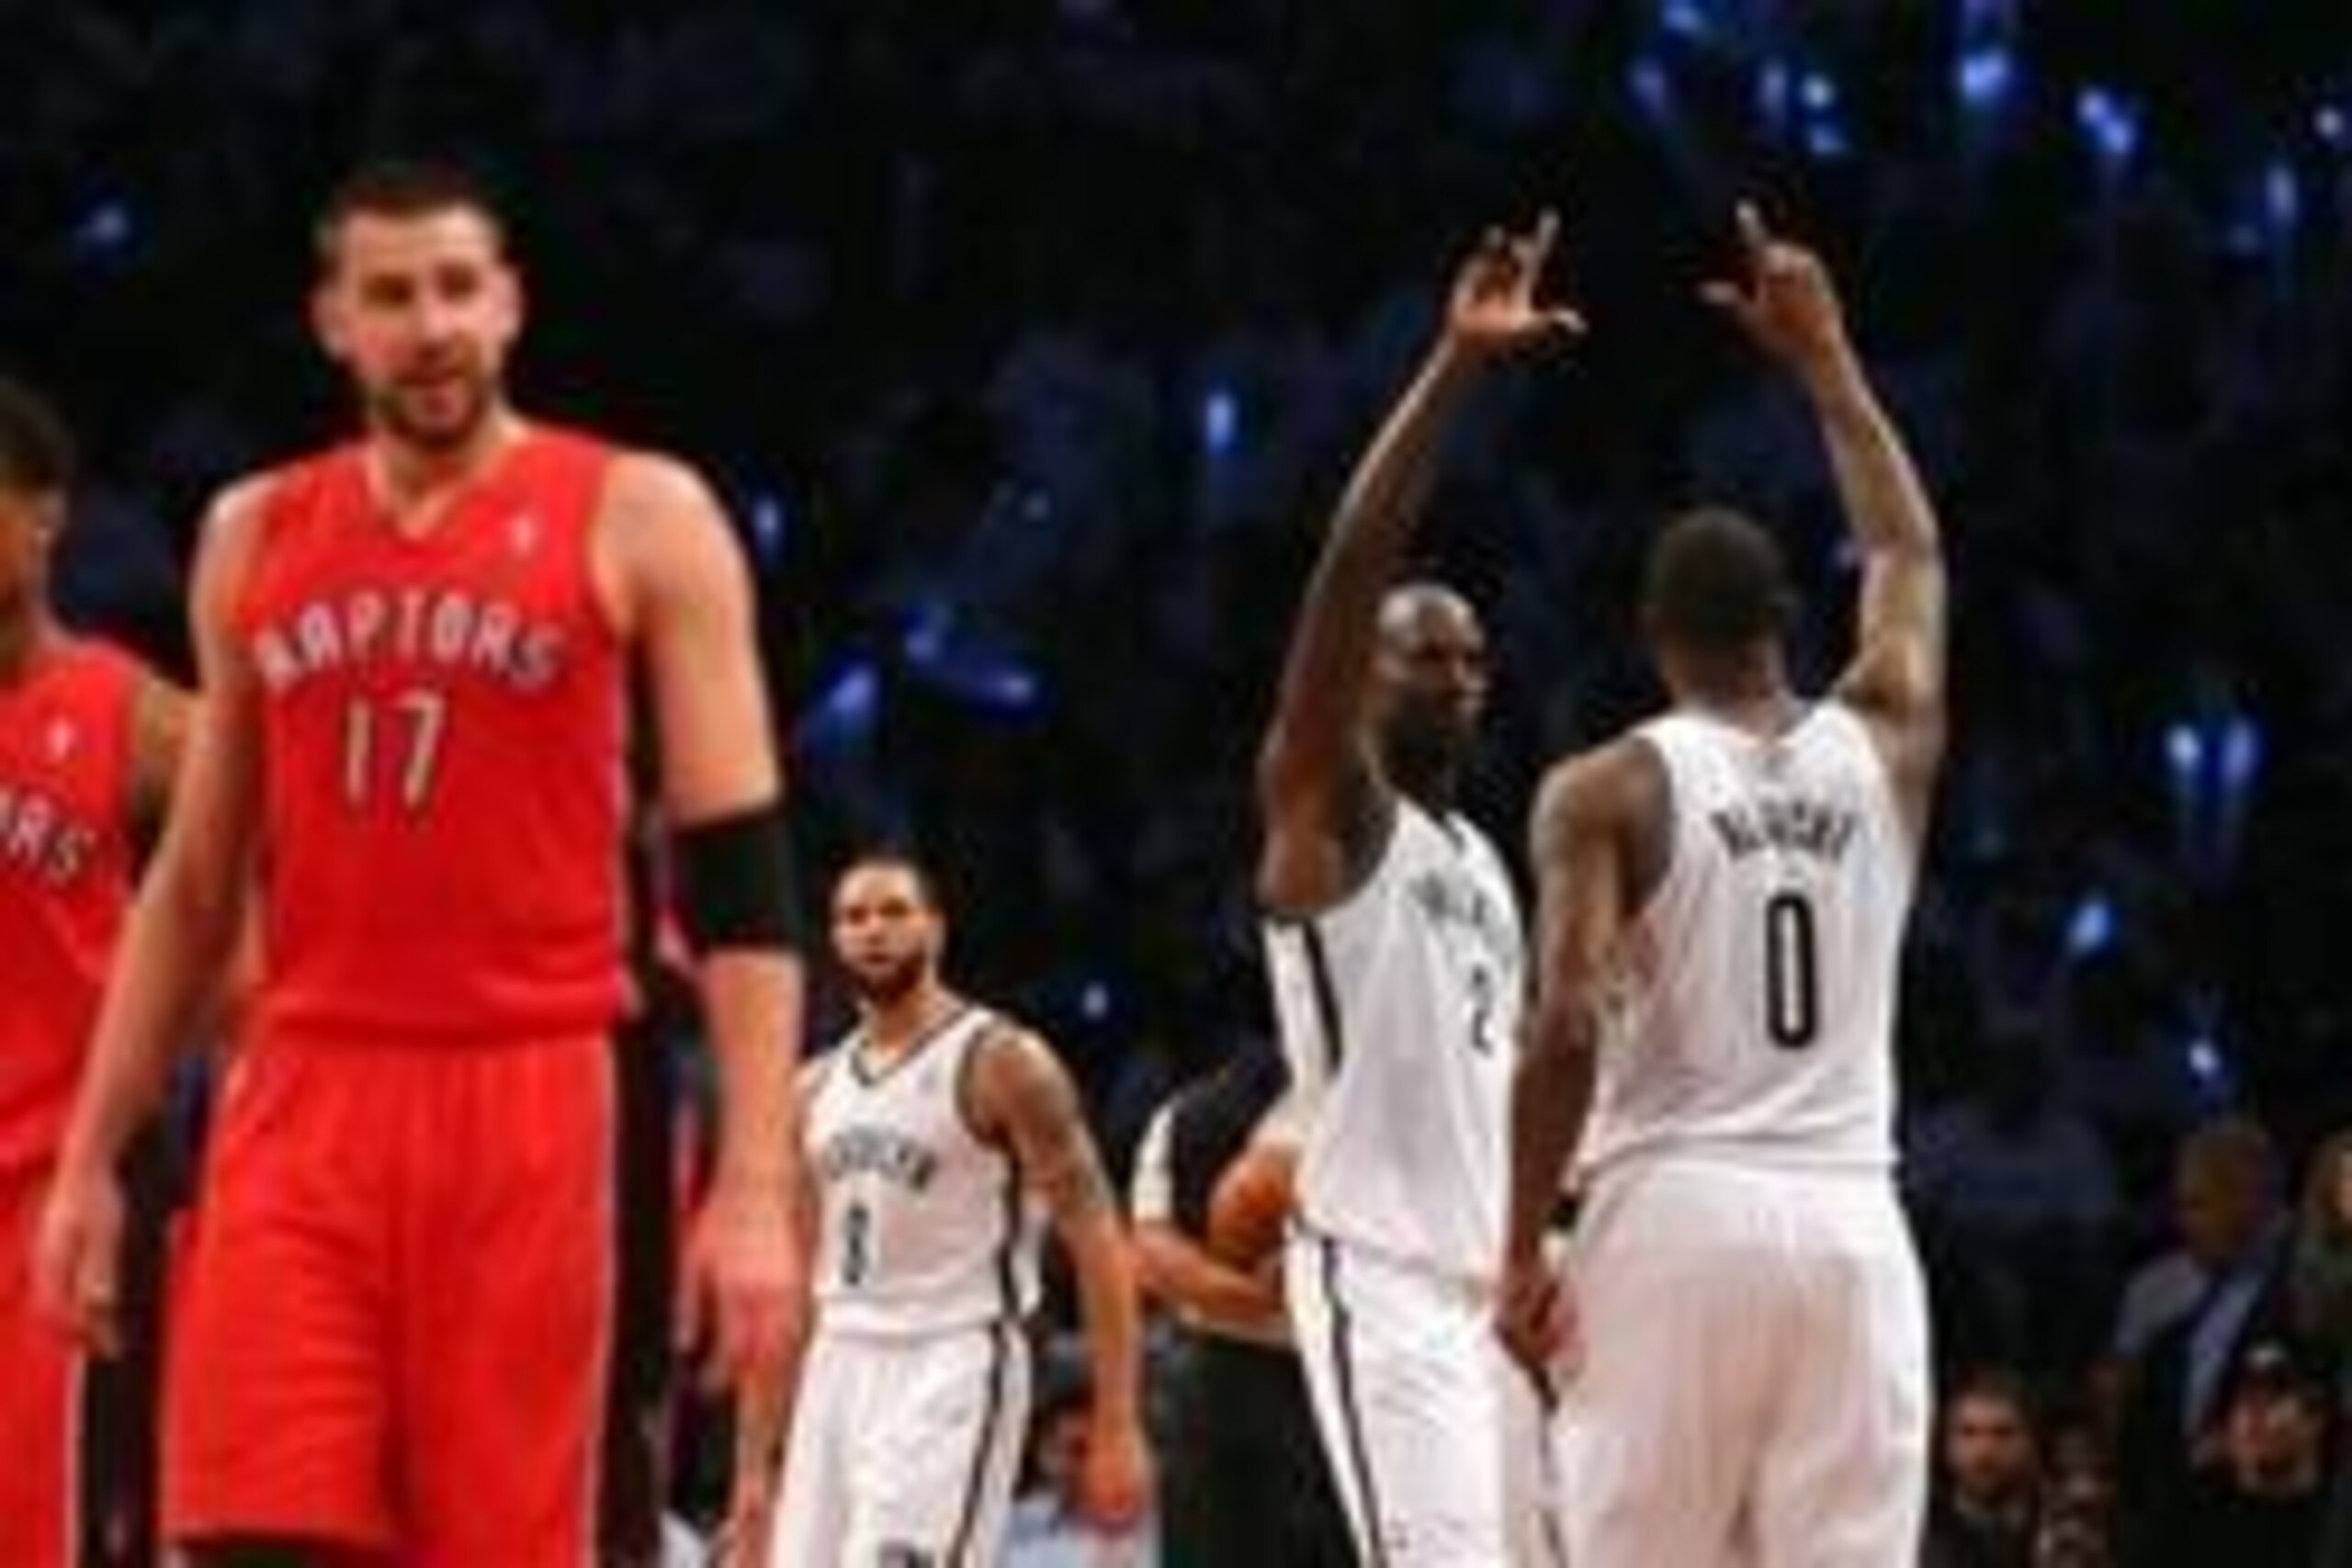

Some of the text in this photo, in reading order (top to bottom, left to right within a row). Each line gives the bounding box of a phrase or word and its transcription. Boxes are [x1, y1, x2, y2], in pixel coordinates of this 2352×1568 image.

[345, 691, 445, 816] 17
[0, 786, 96, 887] RS
[1765, 892, 1819, 1051] 0
